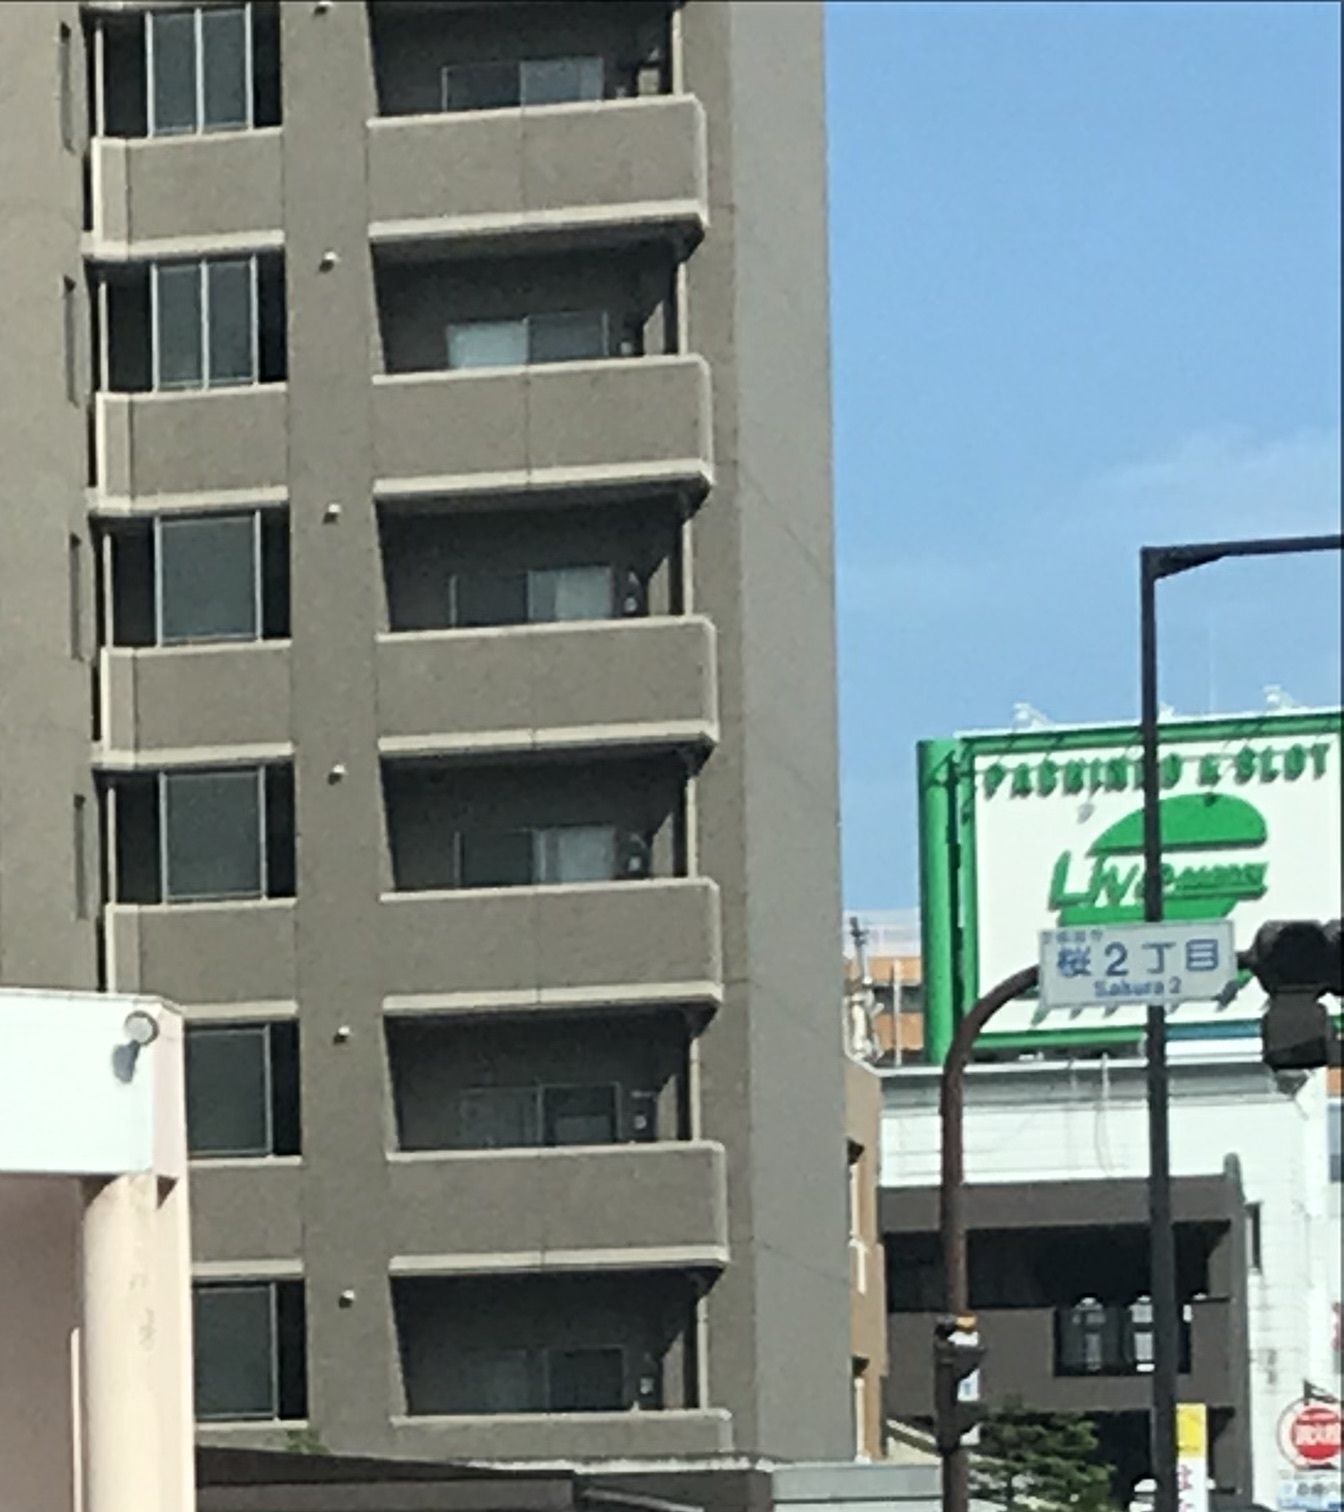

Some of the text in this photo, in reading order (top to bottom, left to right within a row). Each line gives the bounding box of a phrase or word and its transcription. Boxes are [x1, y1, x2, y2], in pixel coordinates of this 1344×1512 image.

[1057, 938, 1219, 978] 桜2丁目
[1094, 976, 1182, 998] Sakura 2
